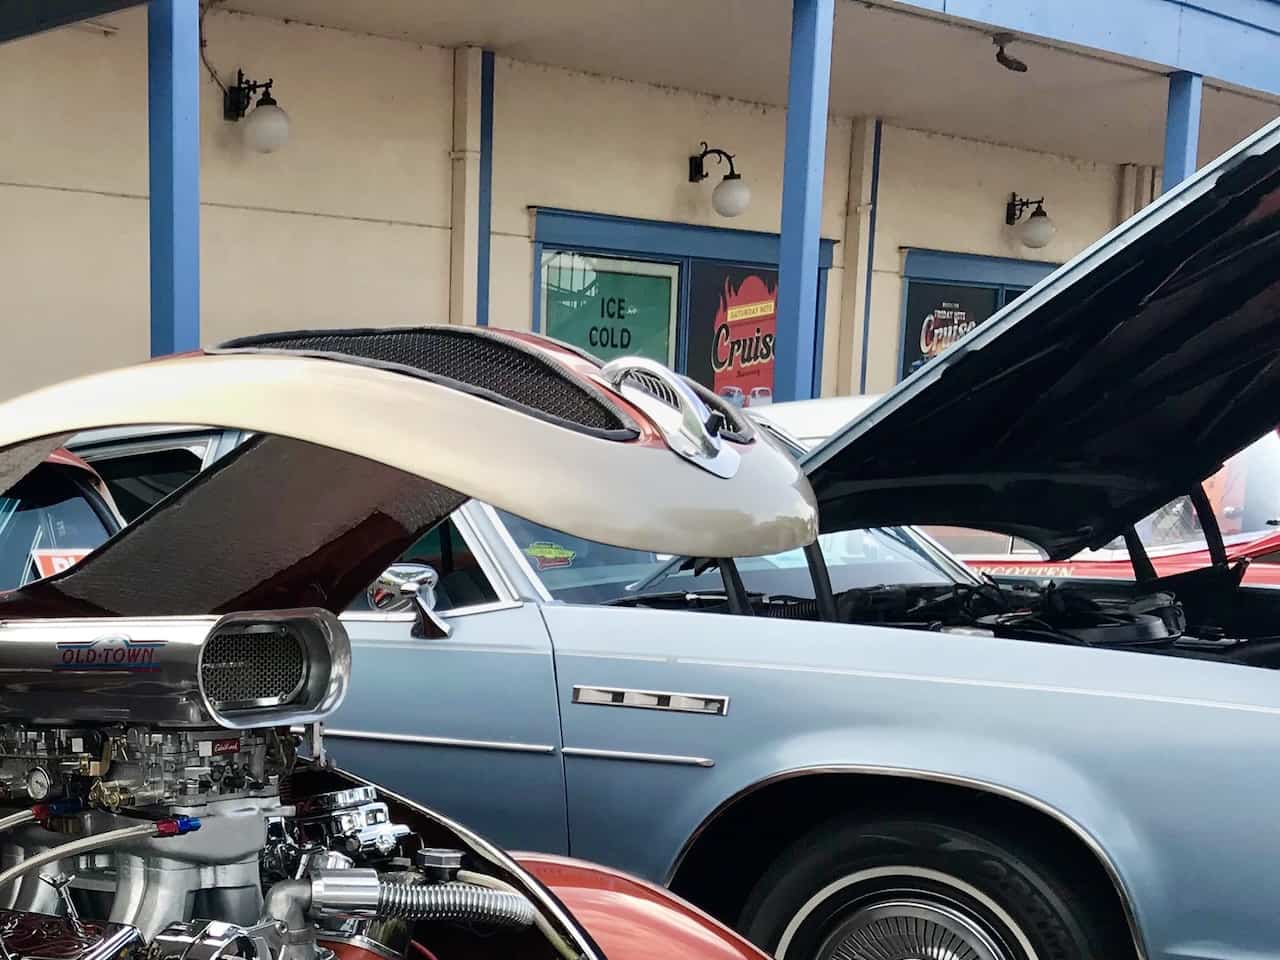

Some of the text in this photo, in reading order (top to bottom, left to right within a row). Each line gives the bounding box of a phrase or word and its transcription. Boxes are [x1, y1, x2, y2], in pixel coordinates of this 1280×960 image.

[601, 297, 625, 319] ICE
[589, 326, 631, 348] COLD
[712, 323, 776, 371] Cruis
